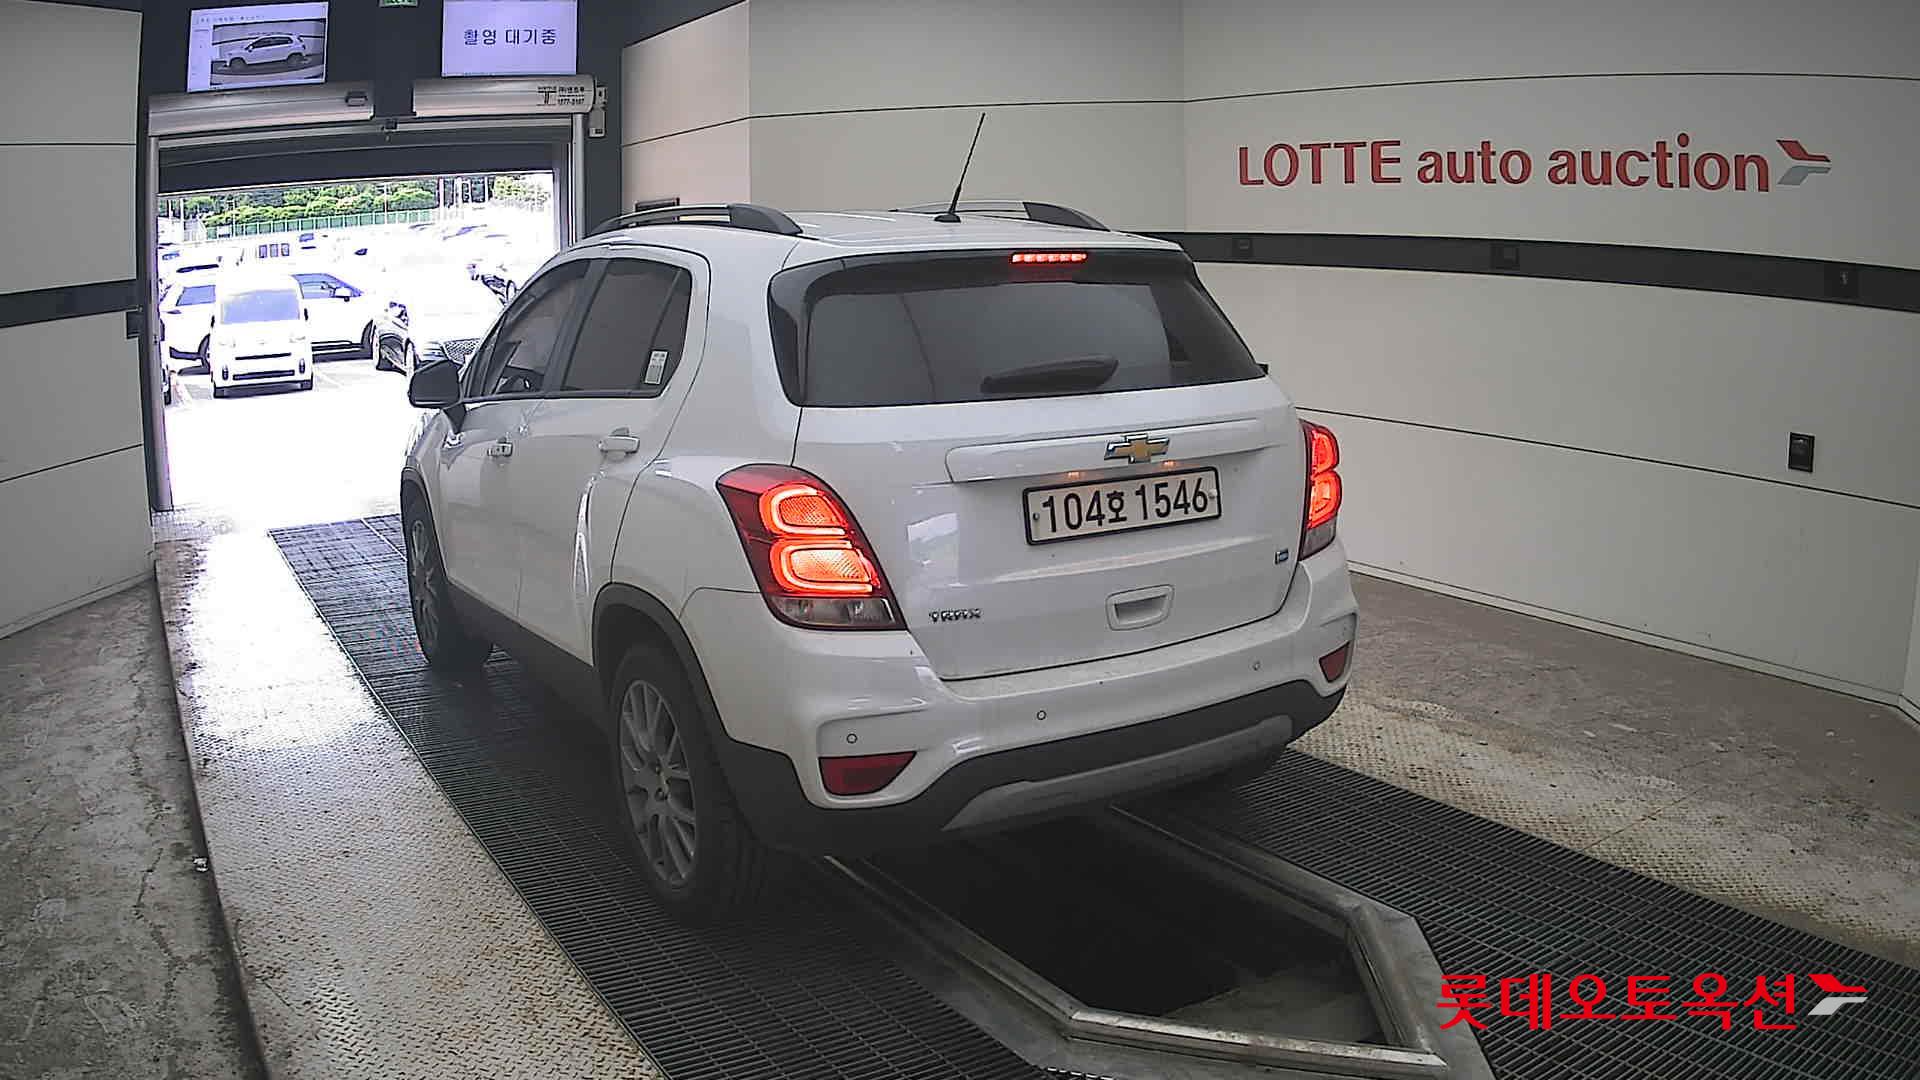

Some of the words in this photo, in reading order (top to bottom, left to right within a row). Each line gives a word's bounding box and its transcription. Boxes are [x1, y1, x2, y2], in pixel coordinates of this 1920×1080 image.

[504, 28, 557, 45] 대기중
[1238, 139, 1401, 187] LOTTE
[1416, 140, 1533, 185] auto
[1547, 132, 1770, 193] auction
[1041, 490, 1128, 534] 104호
[1135, 476, 1209, 521] 1546
[928, 608, 981, 622] TRAX
